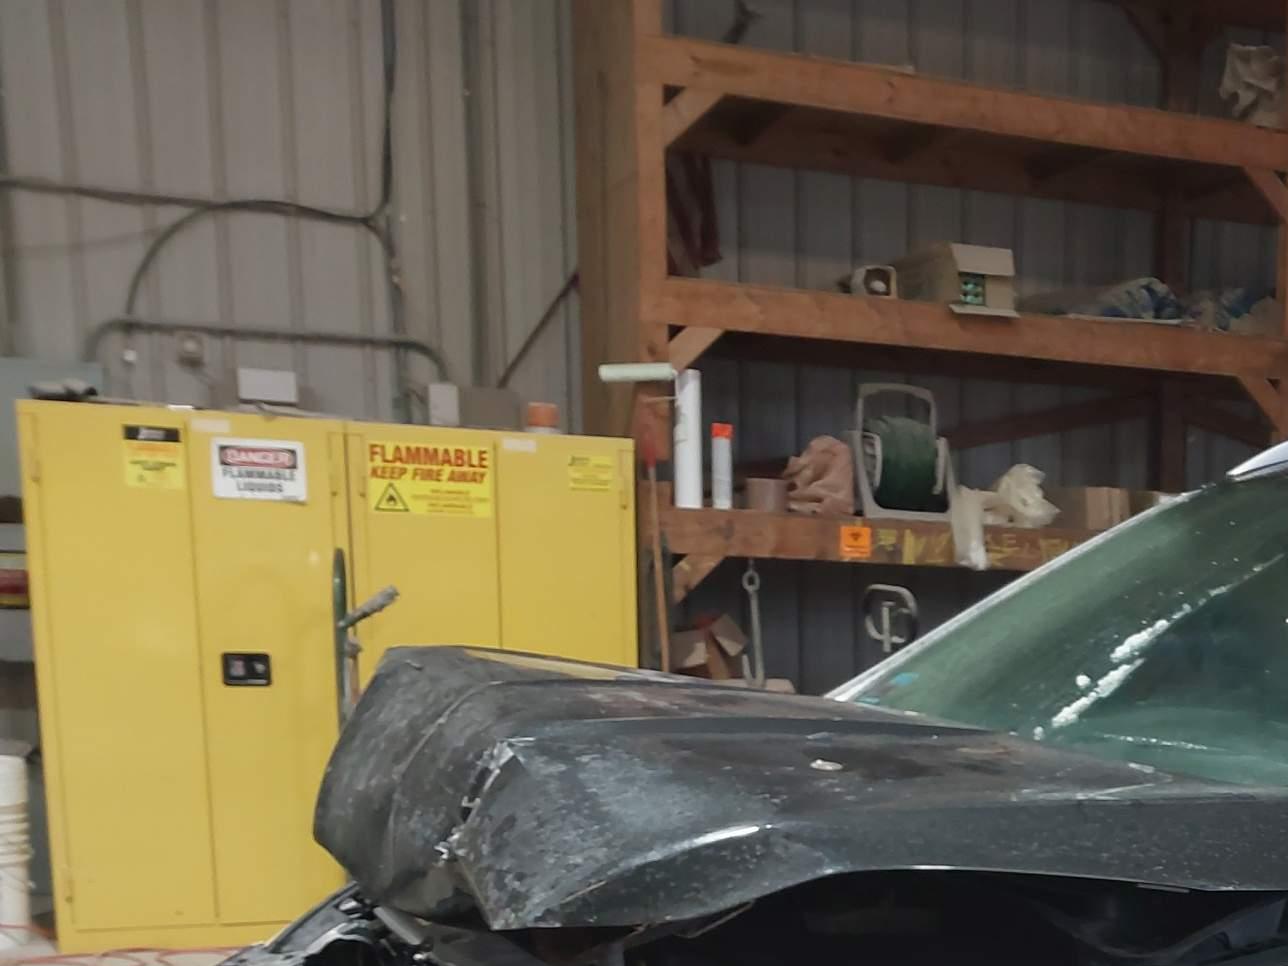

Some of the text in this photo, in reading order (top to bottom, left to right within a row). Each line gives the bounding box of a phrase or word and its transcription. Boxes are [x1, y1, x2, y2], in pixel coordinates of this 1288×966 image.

[223, 448, 292, 466] DANGER
[369, 444, 488, 468] FLAMMABLE
[222, 466, 297, 481] FLAMMABLE
[370, 466, 486, 484] KEEP FIRE AWAY
